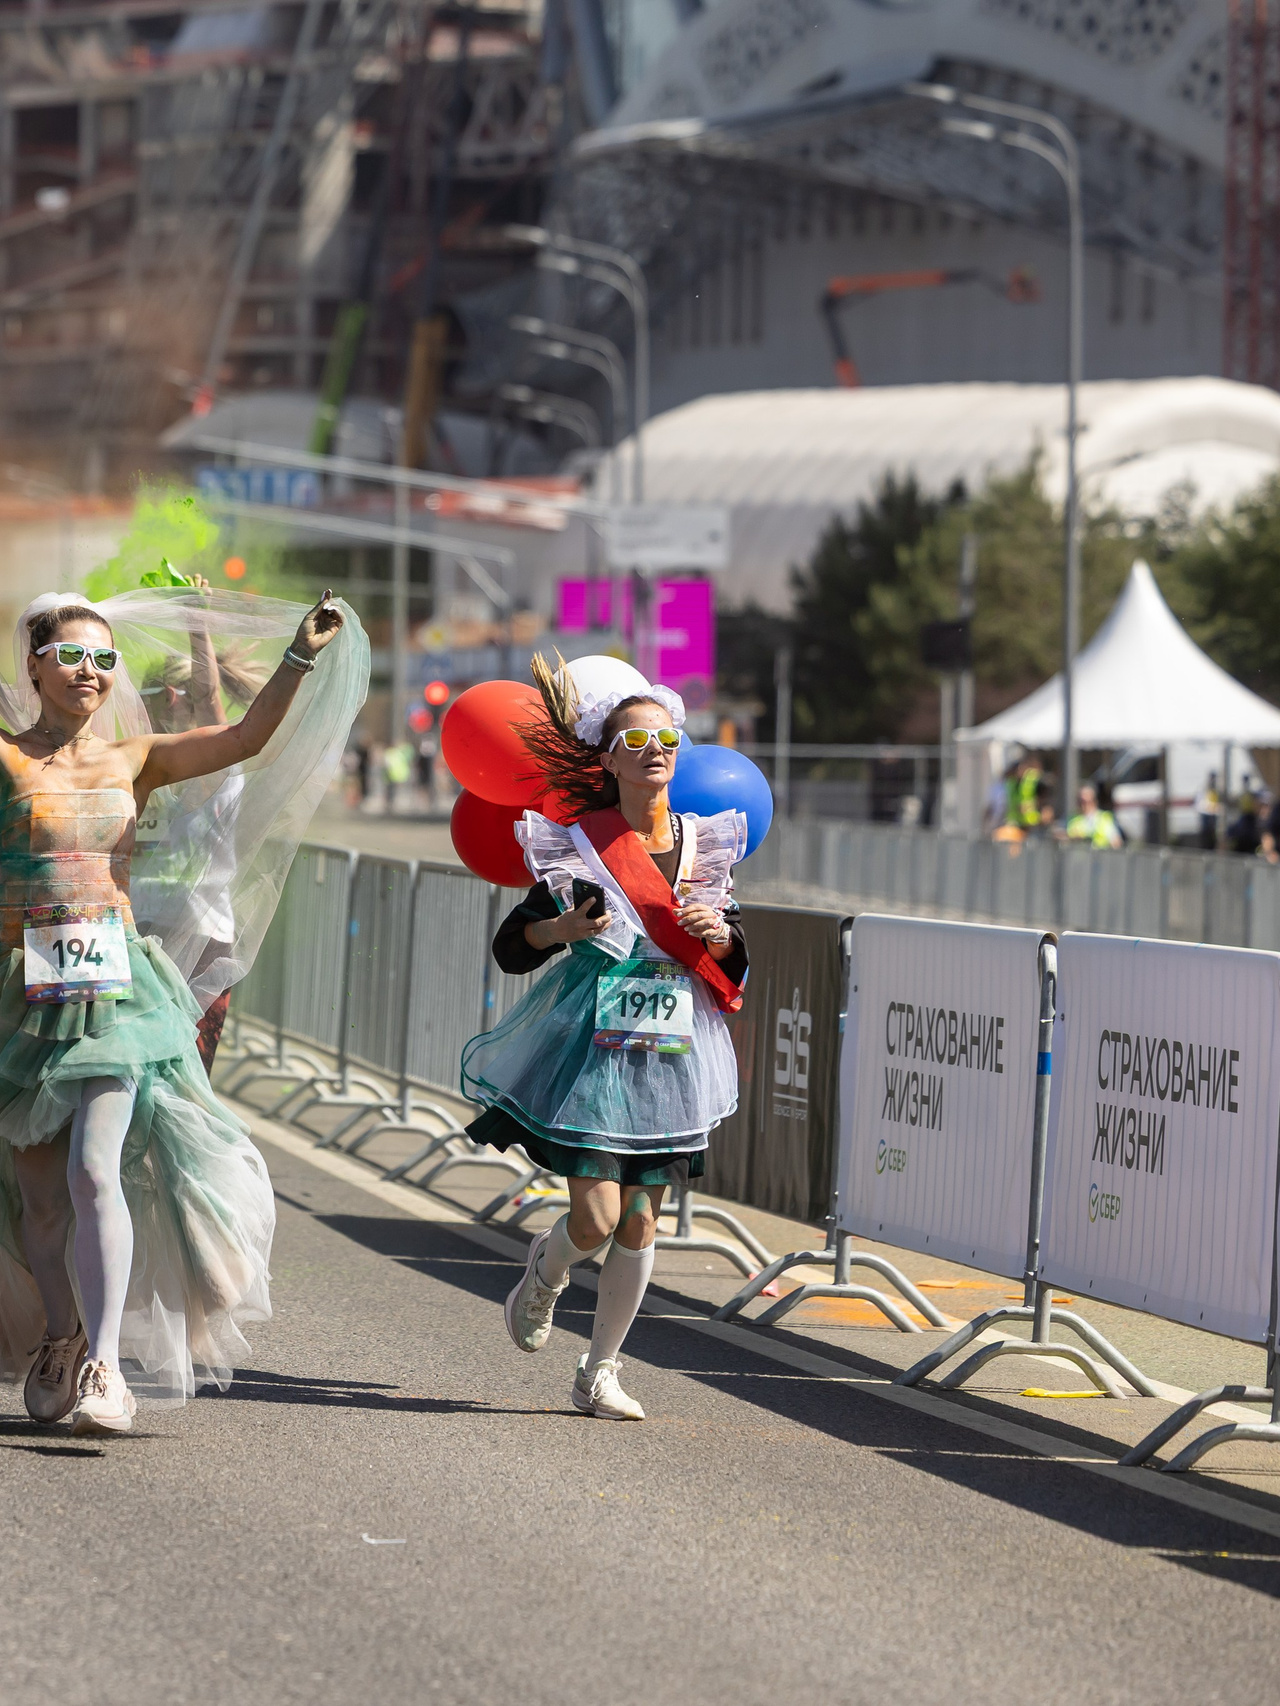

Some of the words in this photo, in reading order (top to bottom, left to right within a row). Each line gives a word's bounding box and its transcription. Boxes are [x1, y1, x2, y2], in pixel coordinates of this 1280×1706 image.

[52, 938, 103, 969] 194
[616, 990, 677, 1021] 1919
[886, 1001, 1005, 1074] СТРАХОВАНИЕ
[1097, 1029, 1240, 1114] СТРАХОВАНИЕ
[881, 1066, 944, 1131] ЖИЗНИ
[888, 1148, 907, 1173] СБЕР
[1092, 1102, 1166, 1176] ЖИЗНИ
[1099, 1193, 1121, 1221] СБЕР
